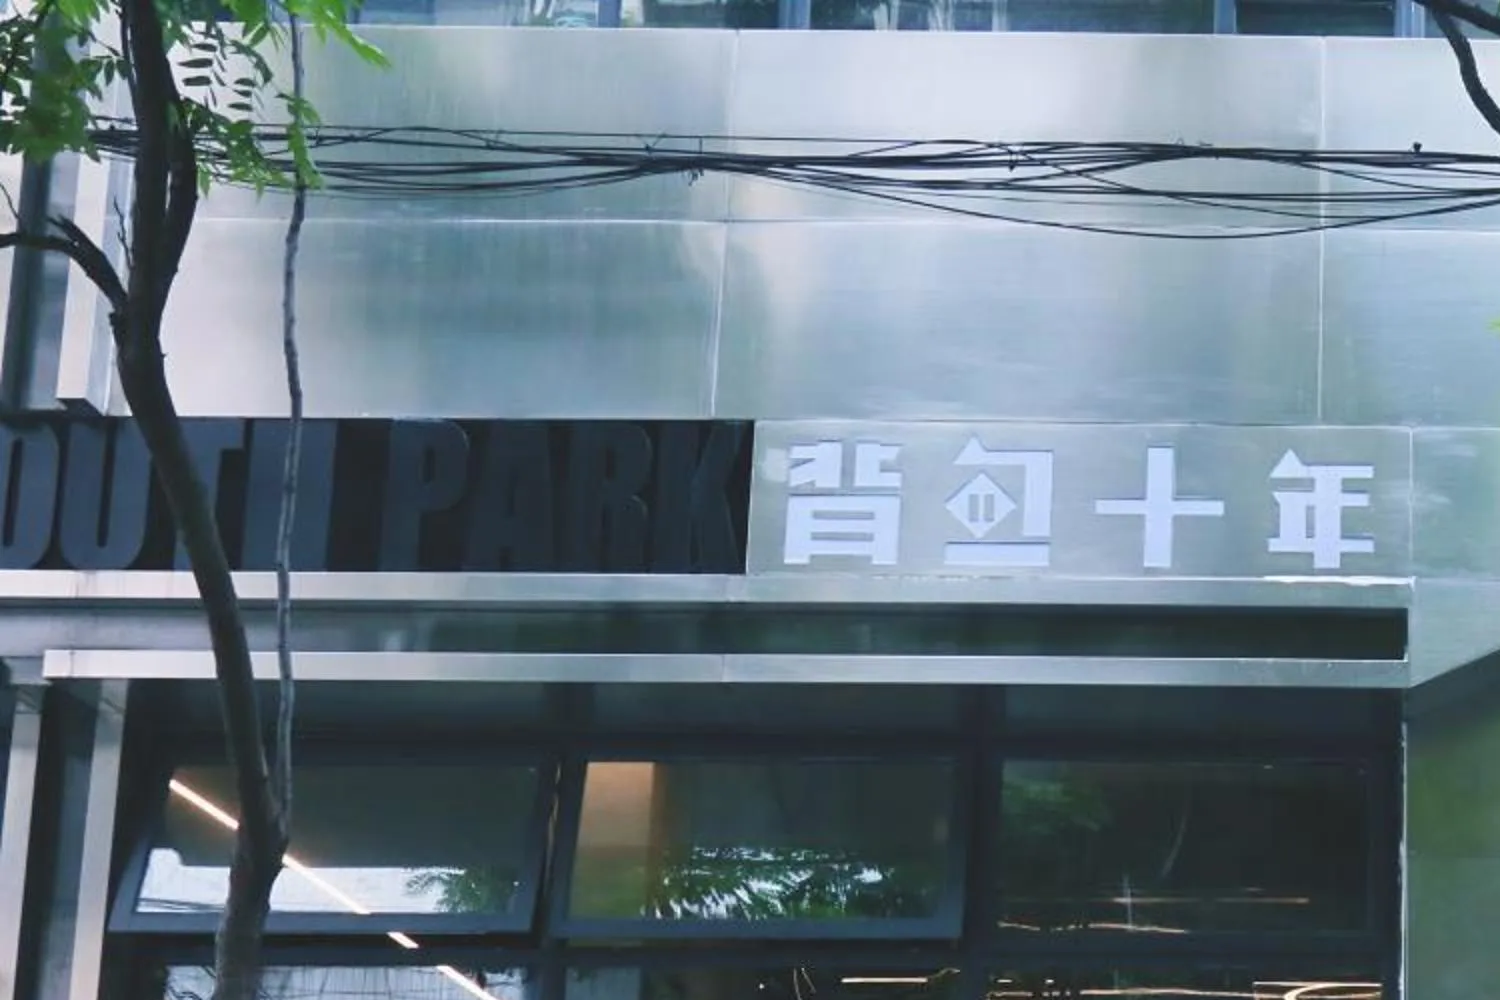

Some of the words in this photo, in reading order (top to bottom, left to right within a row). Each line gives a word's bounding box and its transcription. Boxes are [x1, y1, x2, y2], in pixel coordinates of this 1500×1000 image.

[379, 418, 744, 573] PARK
[784, 437, 1376, 568] 背包十年
